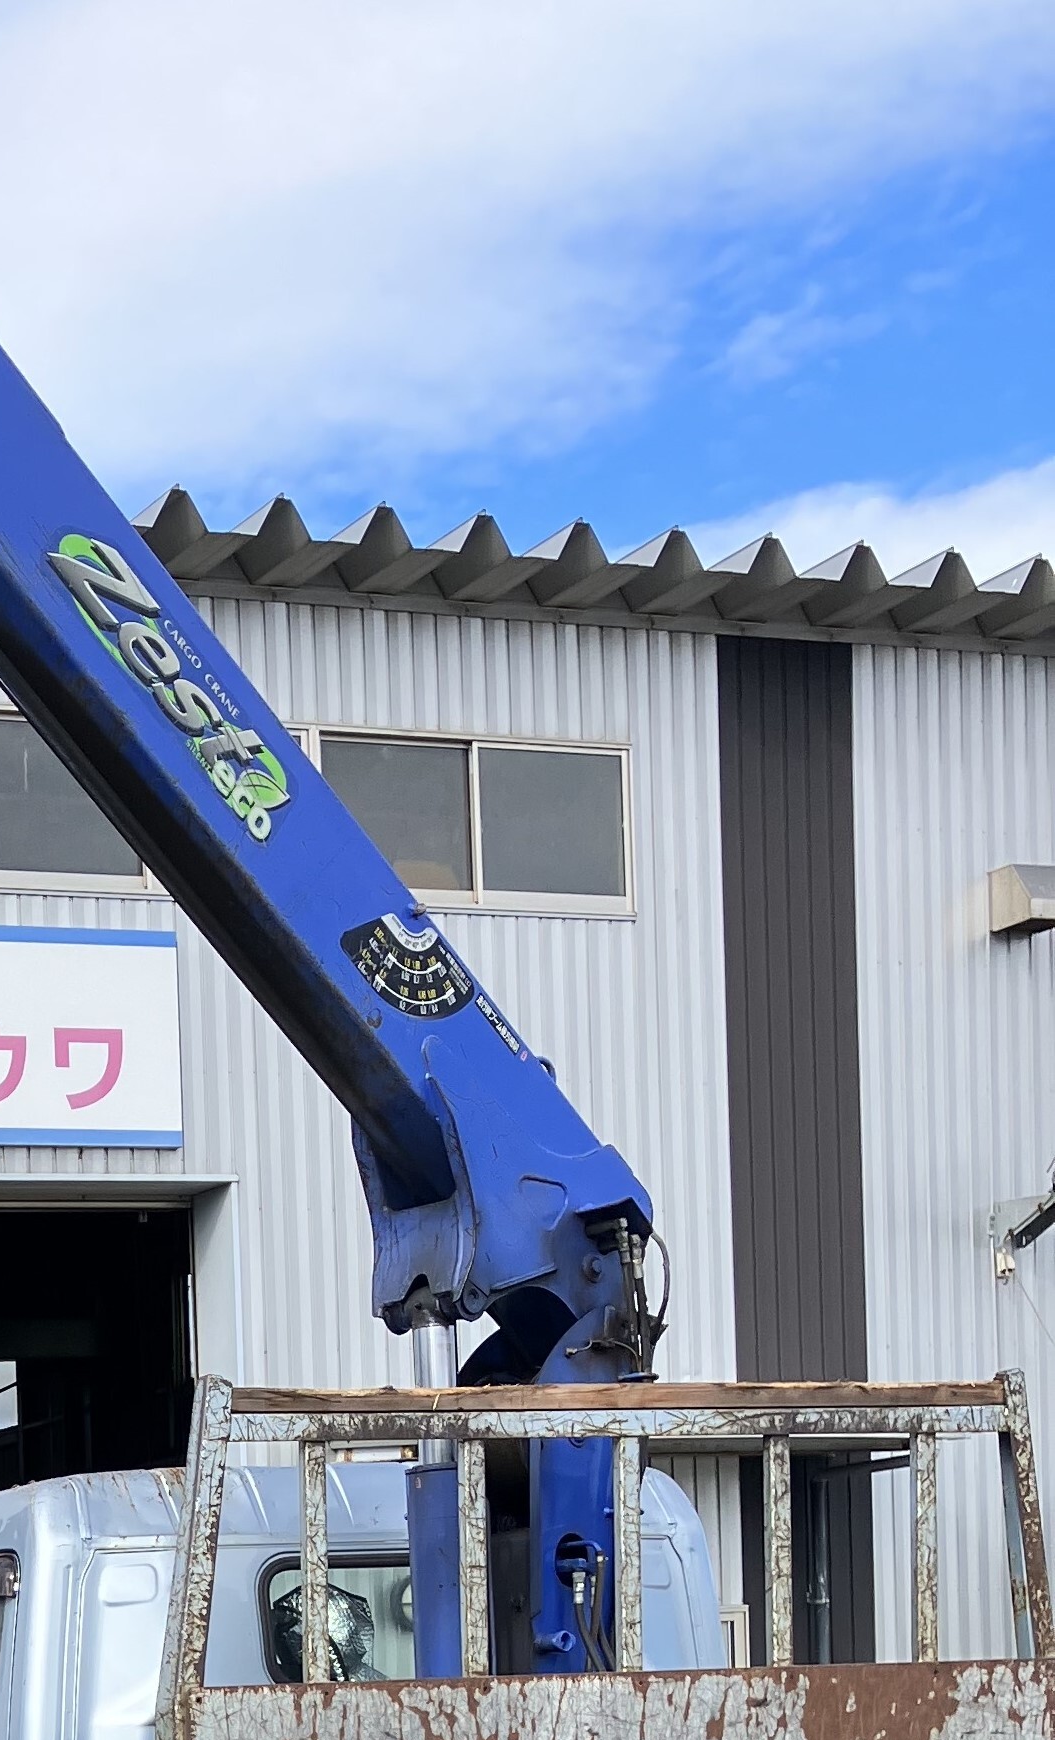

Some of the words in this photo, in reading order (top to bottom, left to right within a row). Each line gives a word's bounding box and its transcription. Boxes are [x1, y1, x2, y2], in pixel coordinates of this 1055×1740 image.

[47, 538, 266, 766] Zest
[164, 619, 202, 669] CARGO
[204, 673, 240, 719] CRANE
[212, 755, 272, 842] eco
